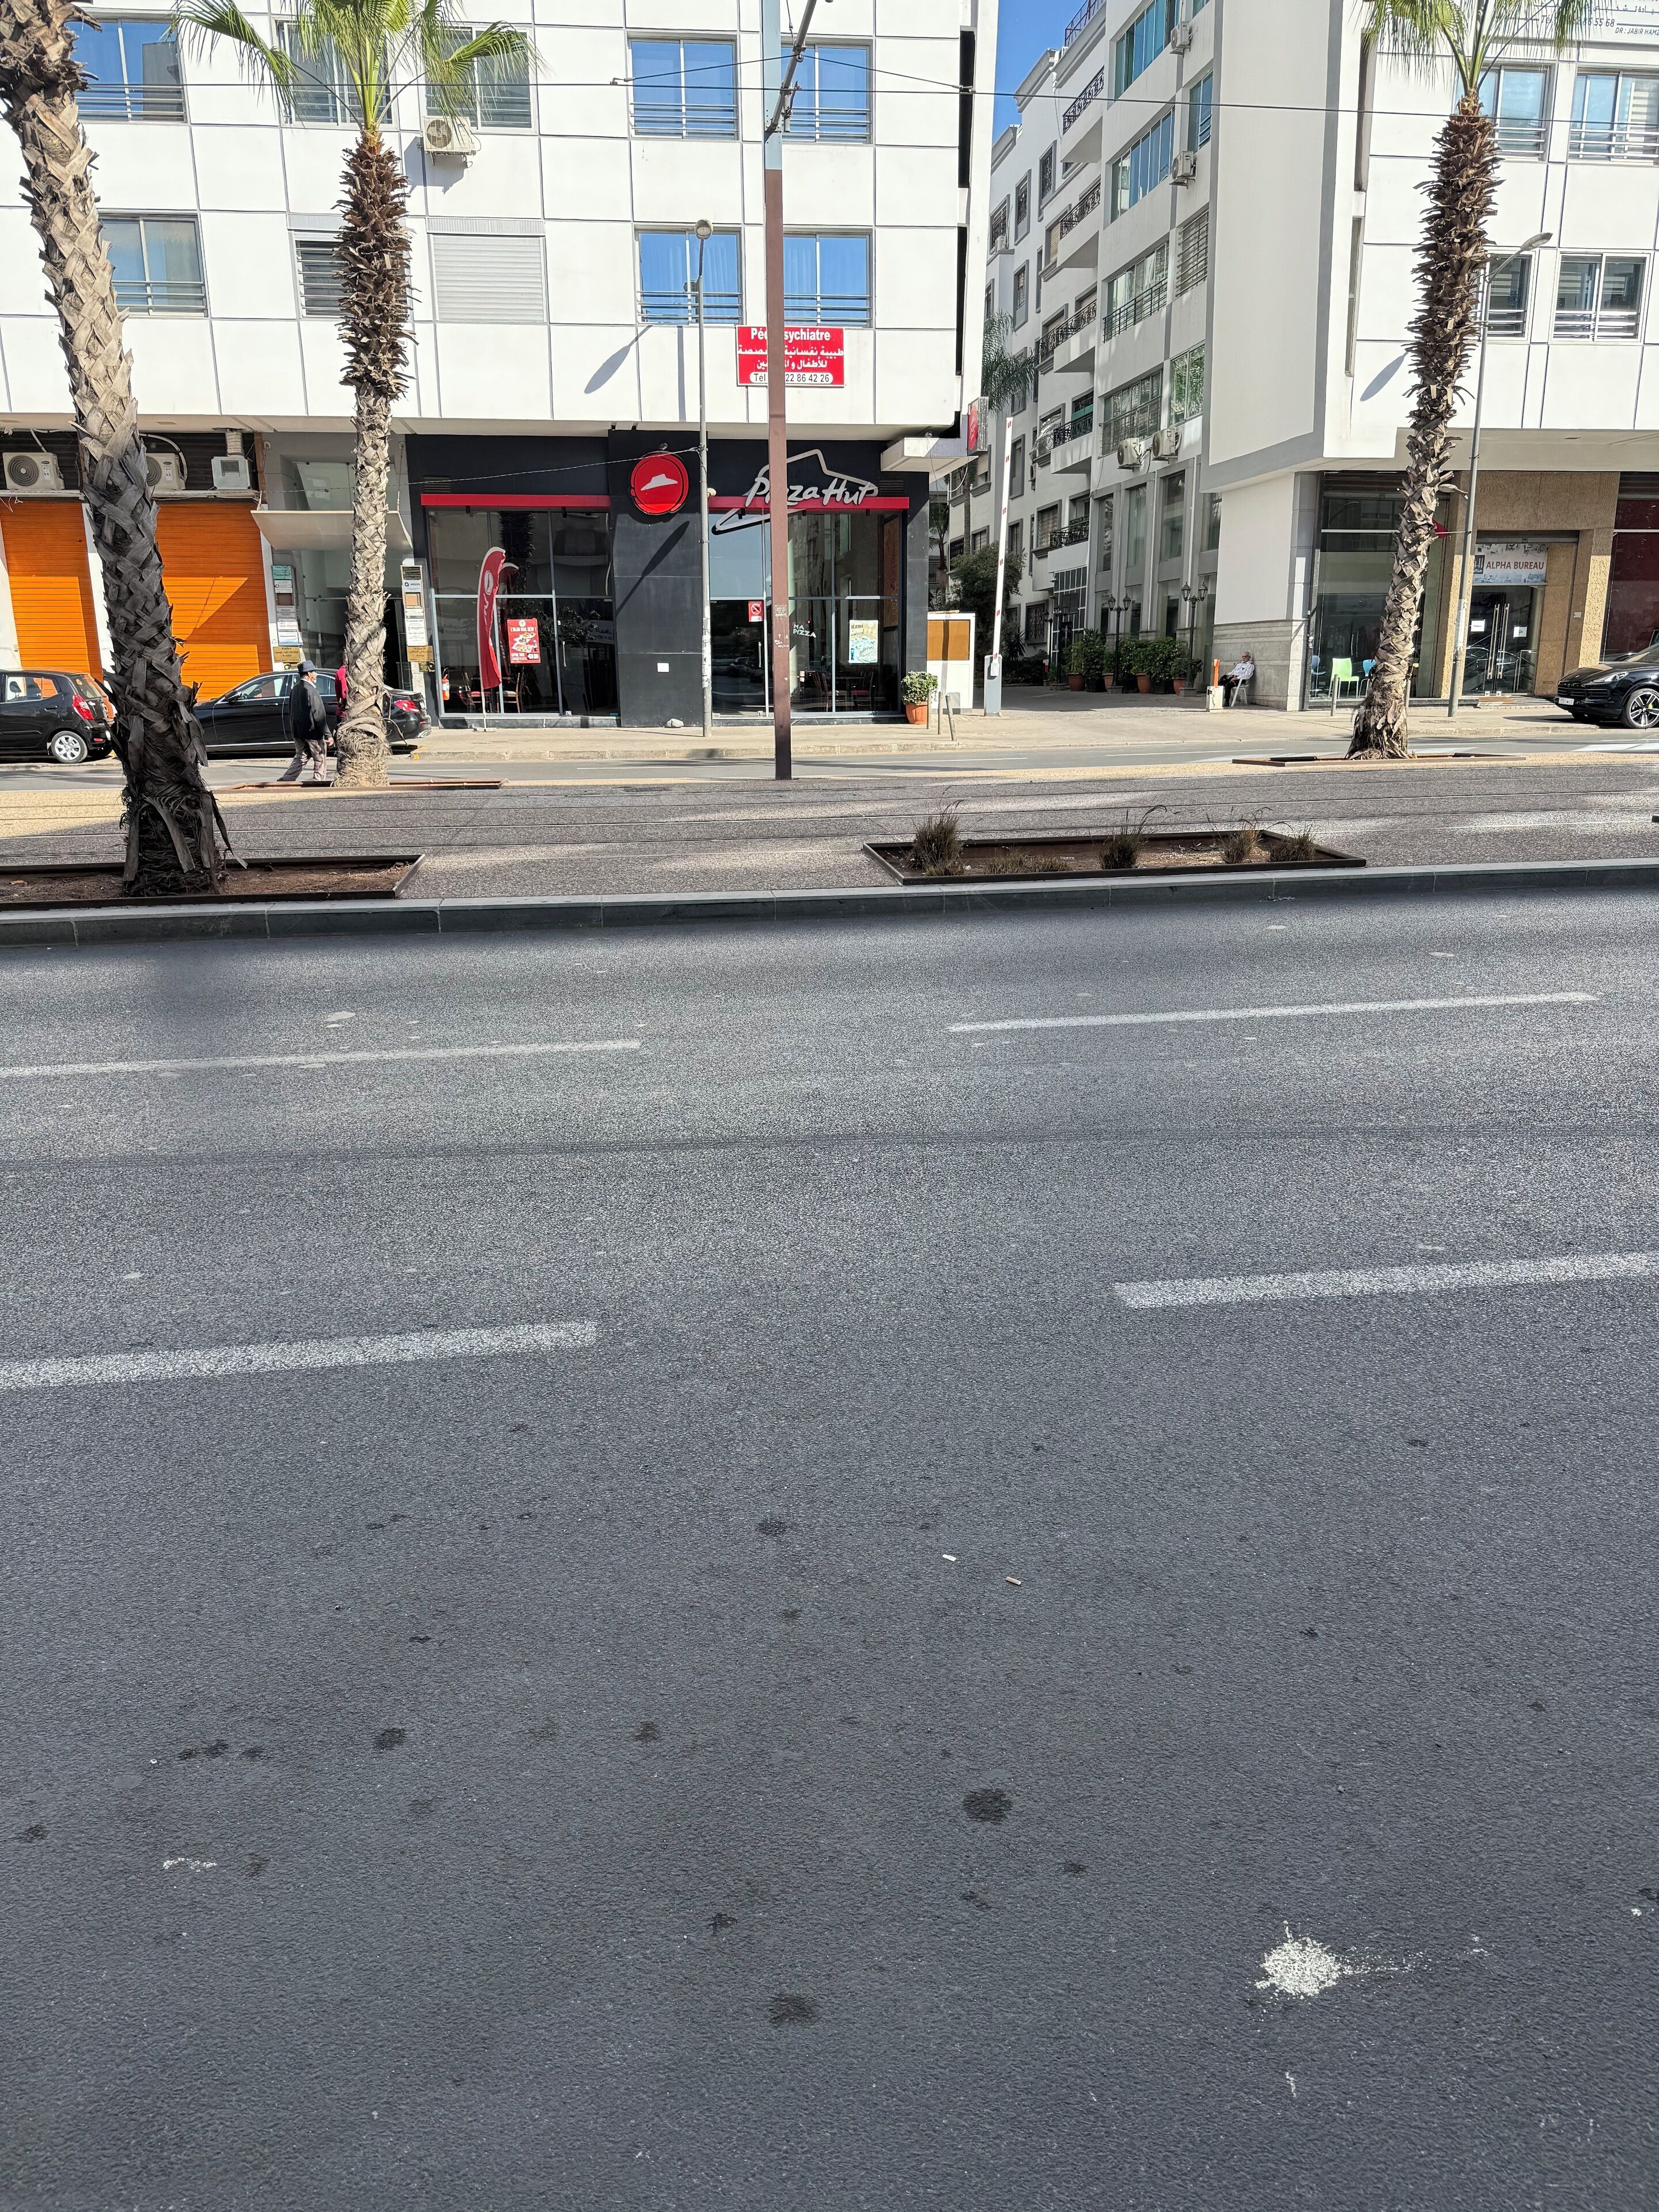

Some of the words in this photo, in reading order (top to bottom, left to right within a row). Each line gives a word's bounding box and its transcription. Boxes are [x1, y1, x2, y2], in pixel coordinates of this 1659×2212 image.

[1594, 18, 1604, 26] 55
[1605, 18, 1615, 27] 68
[751, 327, 831, 343] Pésychiatre
[820, 345, 843, 360] طبيبة
[791, 361, 796, 370] و
[797, 356, 828, 370] للأطفال
[797, 374, 806, 382] 86
[820, 374, 830, 382] 26
[745, 476, 820, 507] Pza
[822, 478, 875, 506] Hut
[1486, 561, 1512, 569] ALPHA
[1513, 561, 1544, 570] BUREAU
[793, 629, 816, 638] PIZZA
